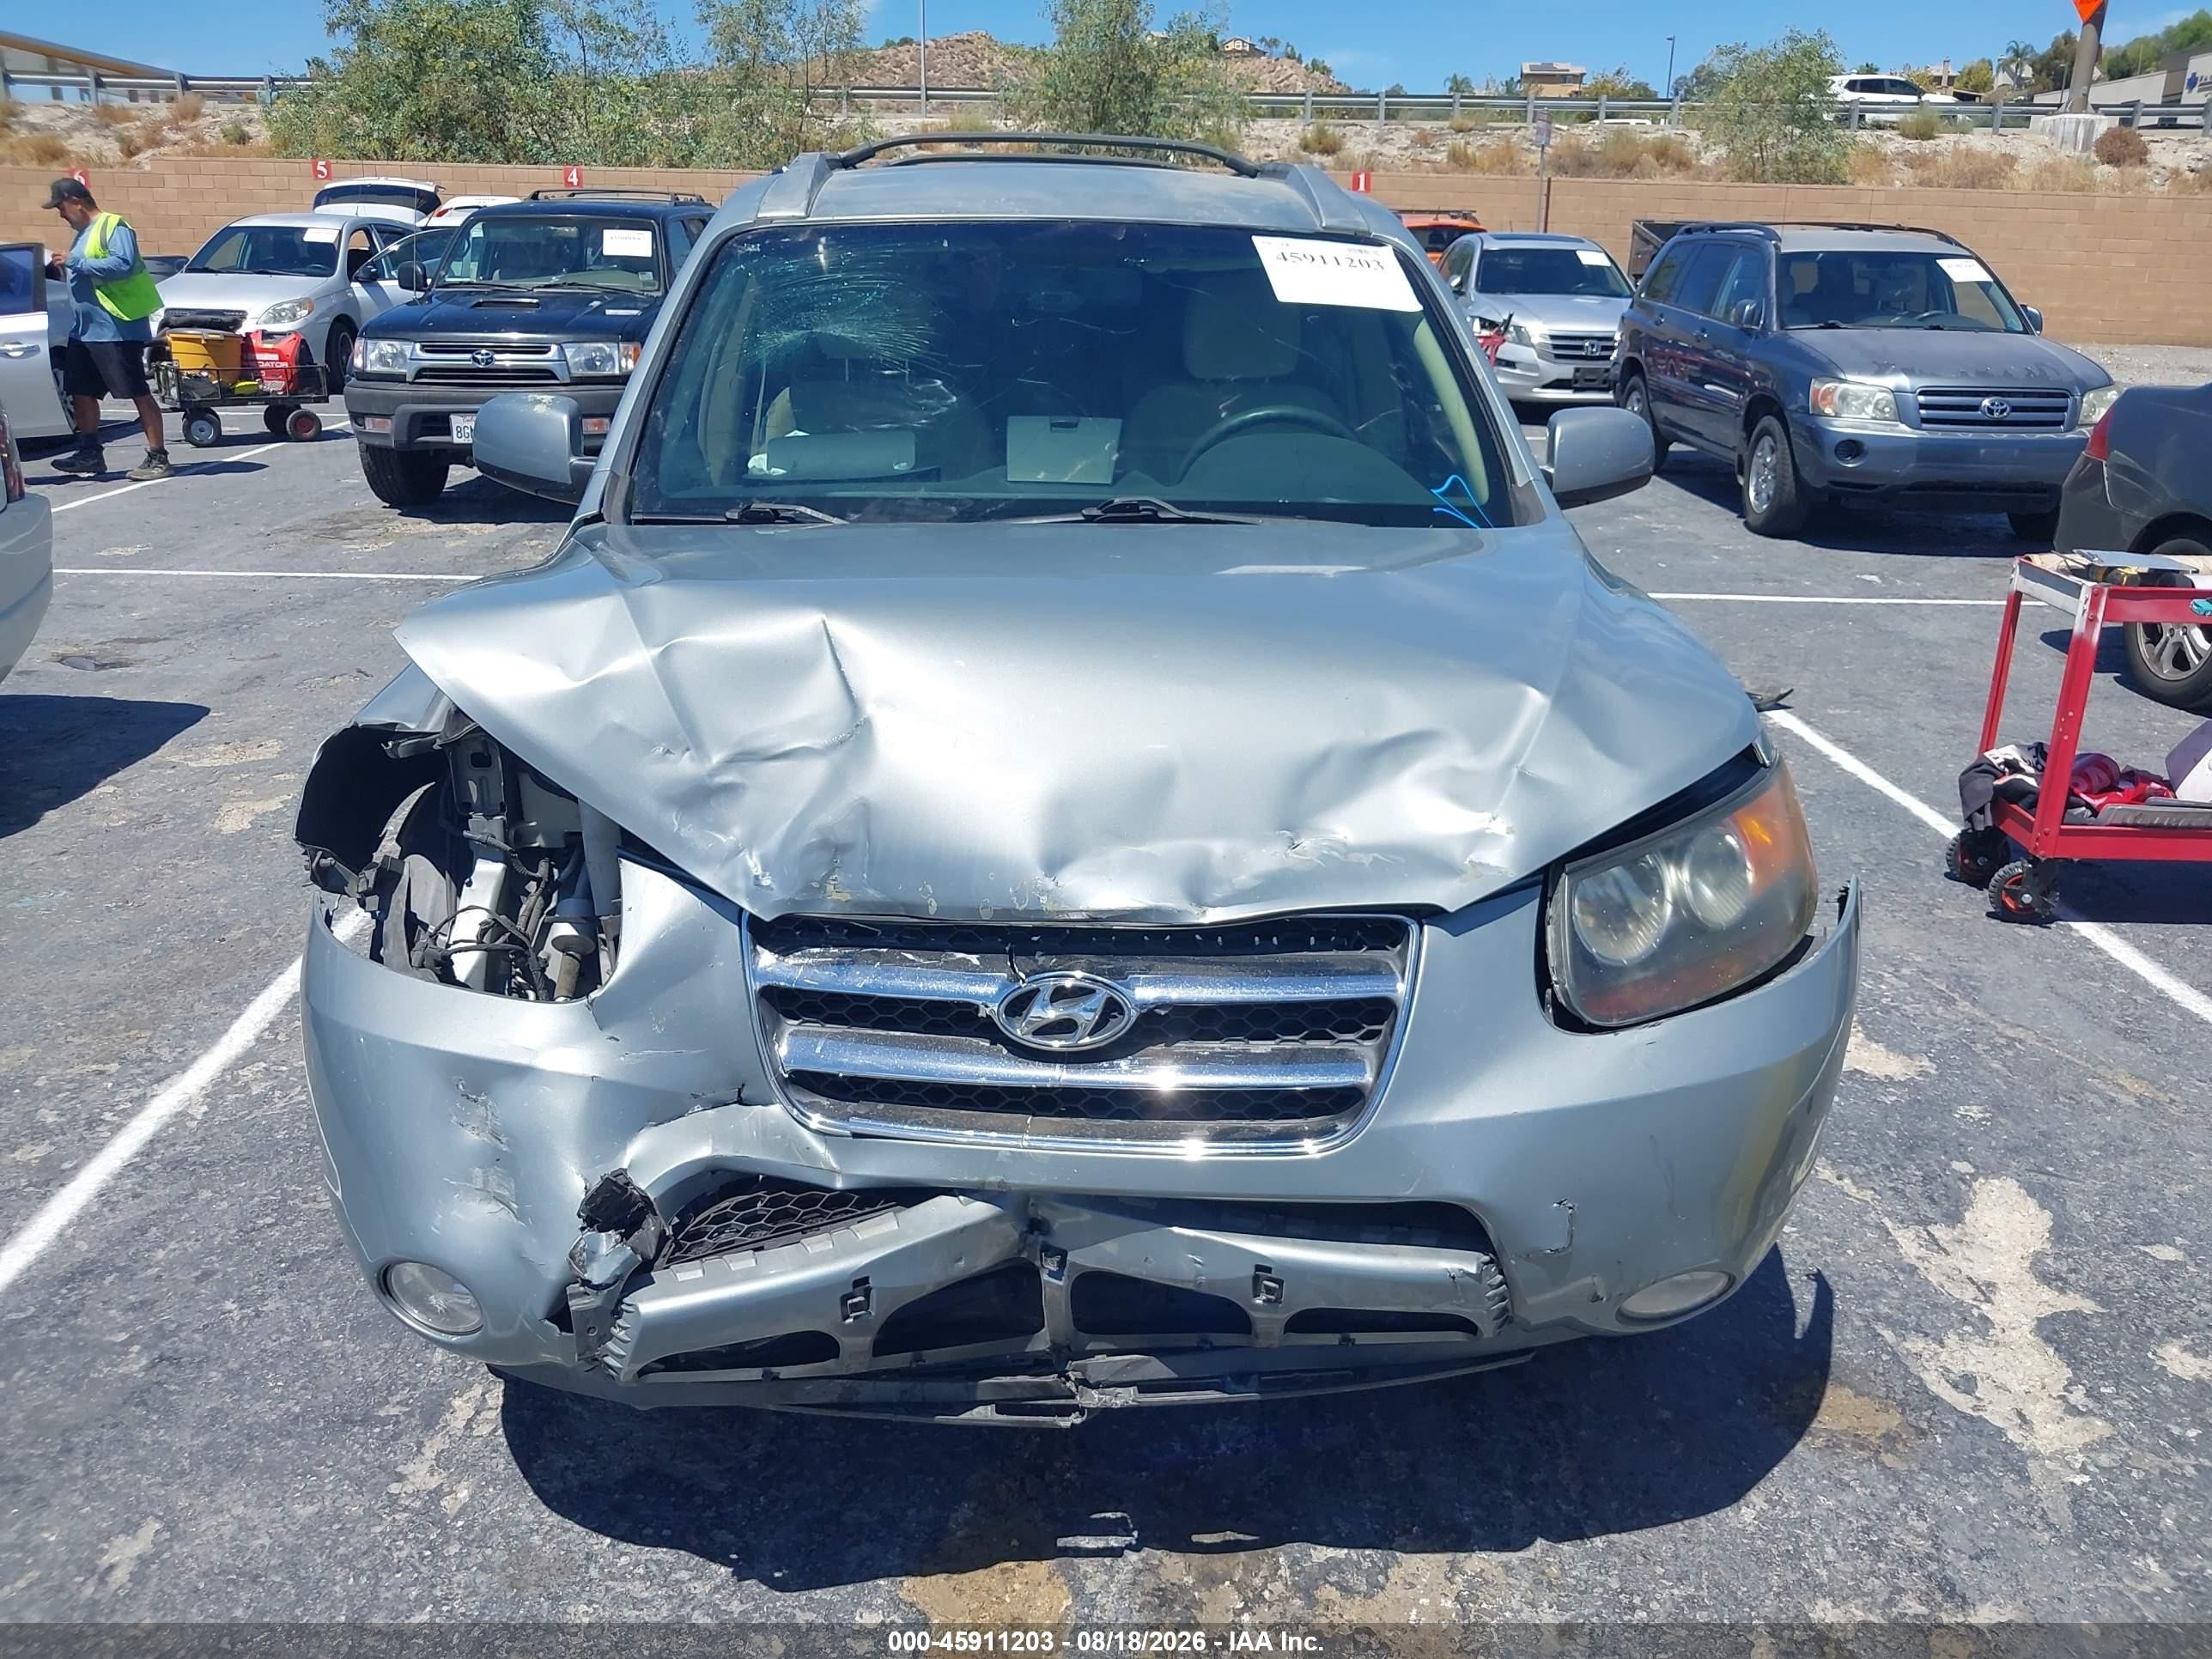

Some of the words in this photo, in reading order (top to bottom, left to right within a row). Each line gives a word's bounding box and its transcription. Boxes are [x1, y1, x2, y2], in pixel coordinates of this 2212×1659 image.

[317, 161, 328, 179] 5
[567, 167, 579, 186] 4
[1358, 172, 1365, 191] 1
[1276, 251, 1385, 271] 45911203
